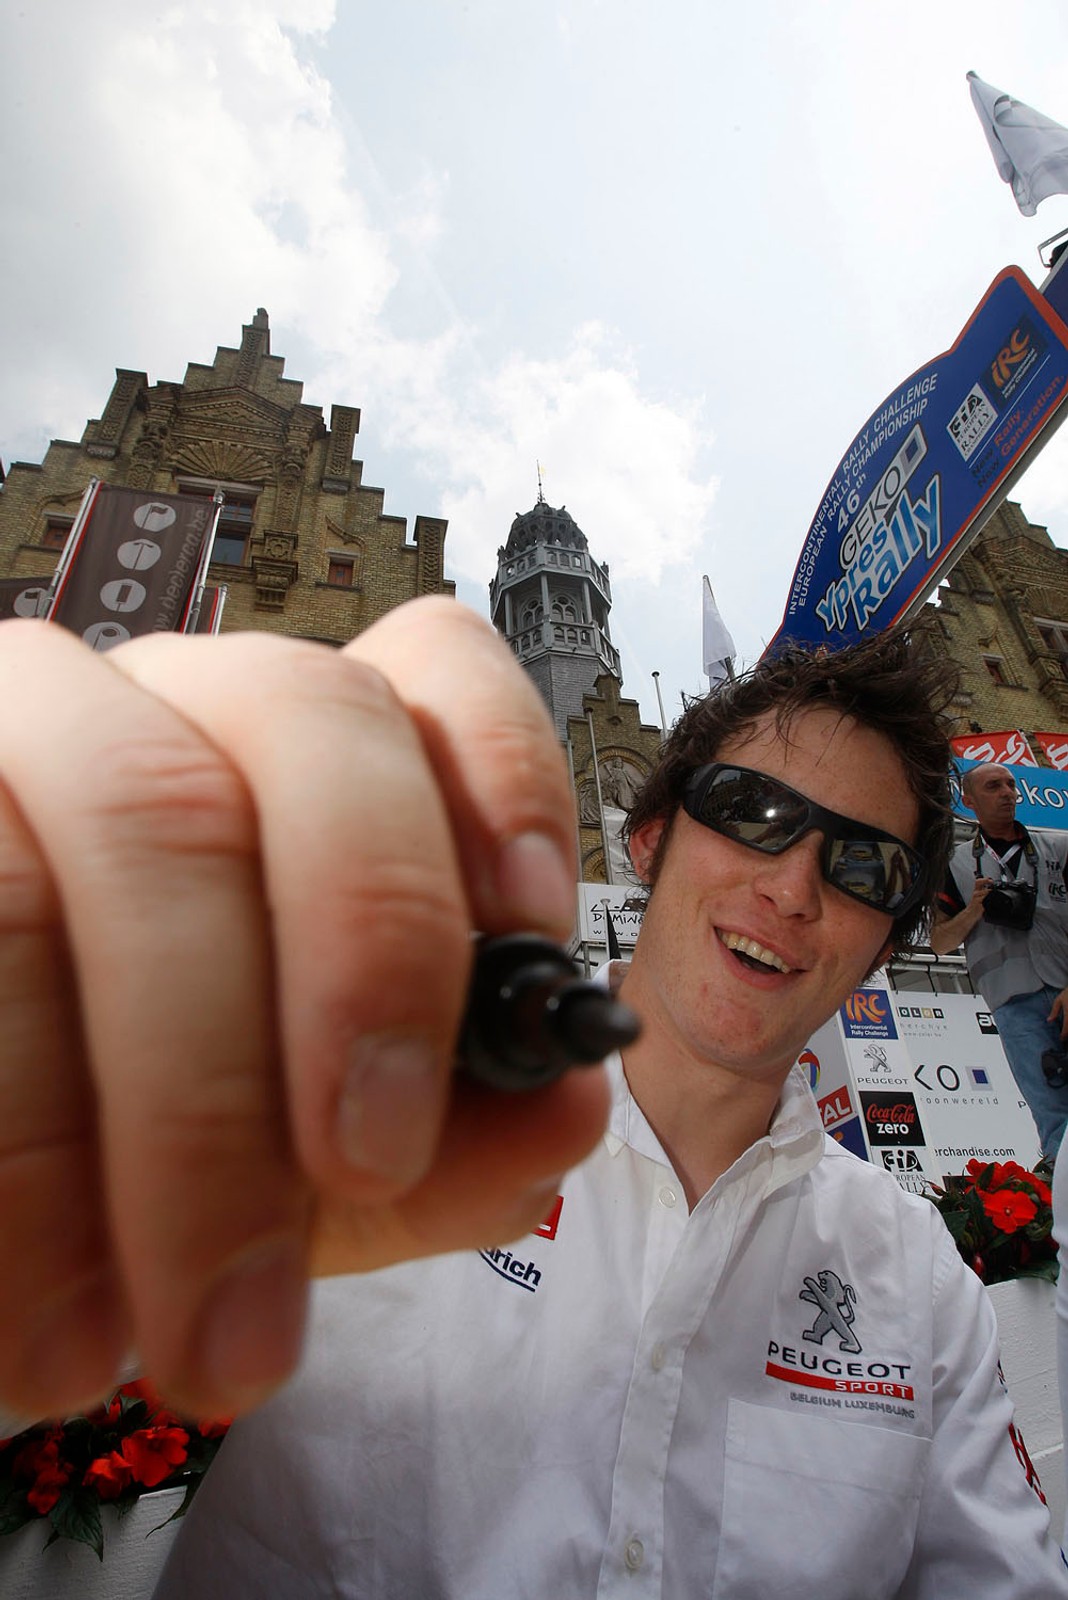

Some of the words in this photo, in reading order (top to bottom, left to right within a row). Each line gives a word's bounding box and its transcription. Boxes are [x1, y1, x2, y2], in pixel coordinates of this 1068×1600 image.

[991, 329, 1030, 387] IRC
[961, 412, 990, 452] RALLY
[789, 479, 842, 615] INTERCONTINENTAL
[842, 429, 870, 473] RALLY
[873, 373, 938, 433] CHALLENGE
[799, 527, 828, 607] EUROPEAN
[826, 475, 851, 521] RALLY
[851, 398, 928, 478] CHAMPIONSHIP
[841, 466, 900, 566] GEKO
[851, 474, 941, 631] Rally
[816, 518, 890, 631] Ypres
[846, 993, 886, 1023] IRC
[897, 1006, 944, 1018] OLOR
[820, 1097, 851, 1126] AL
[866, 1103, 917, 1124] Coca-Cola
[920, 1096, 999, 1105] oonwereld
[877, 1123, 910, 1135] zero
[768, 1340, 912, 1380] PEUGEOT
[790, 1391, 843, 1409] BELGIUM
[845, 1399, 916, 1419] LUXEMBURG
[835, 1380, 909, 1399] SPORT
